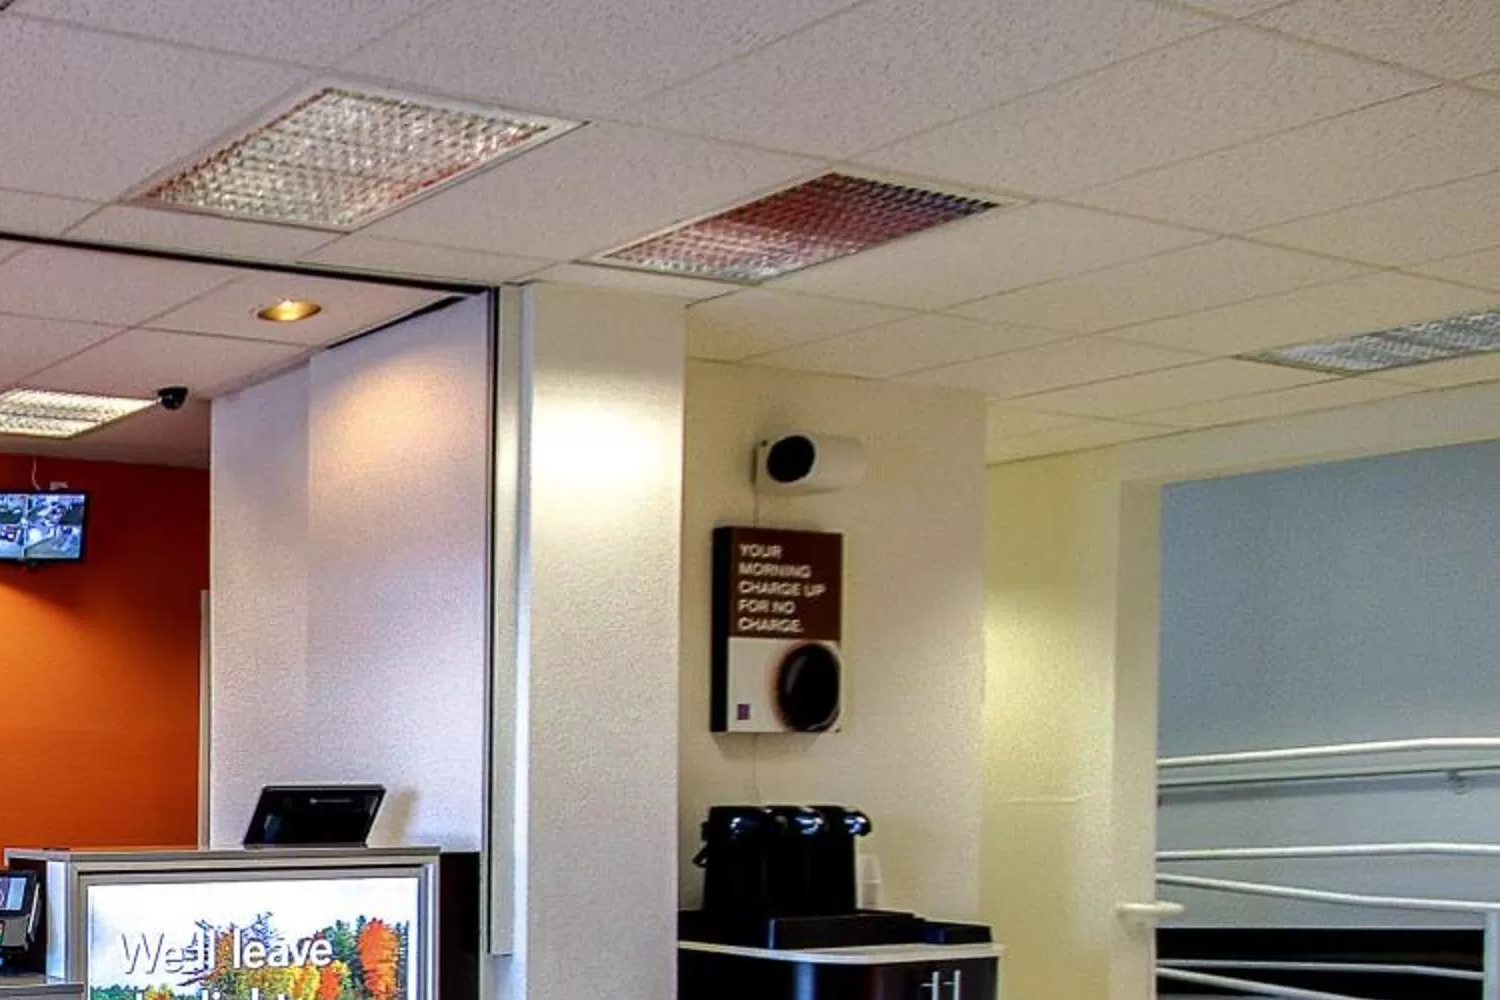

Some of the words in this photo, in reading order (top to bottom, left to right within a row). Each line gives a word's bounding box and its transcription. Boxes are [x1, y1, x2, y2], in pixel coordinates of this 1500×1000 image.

[738, 543, 783, 559] YOUR
[738, 562, 812, 579] MORNING
[738, 580, 802, 597] CHARGE
[803, 583, 827, 598] UP
[738, 598, 770, 614] FOR
[771, 600, 797, 615] NO
[232, 923, 334, 970] leave
